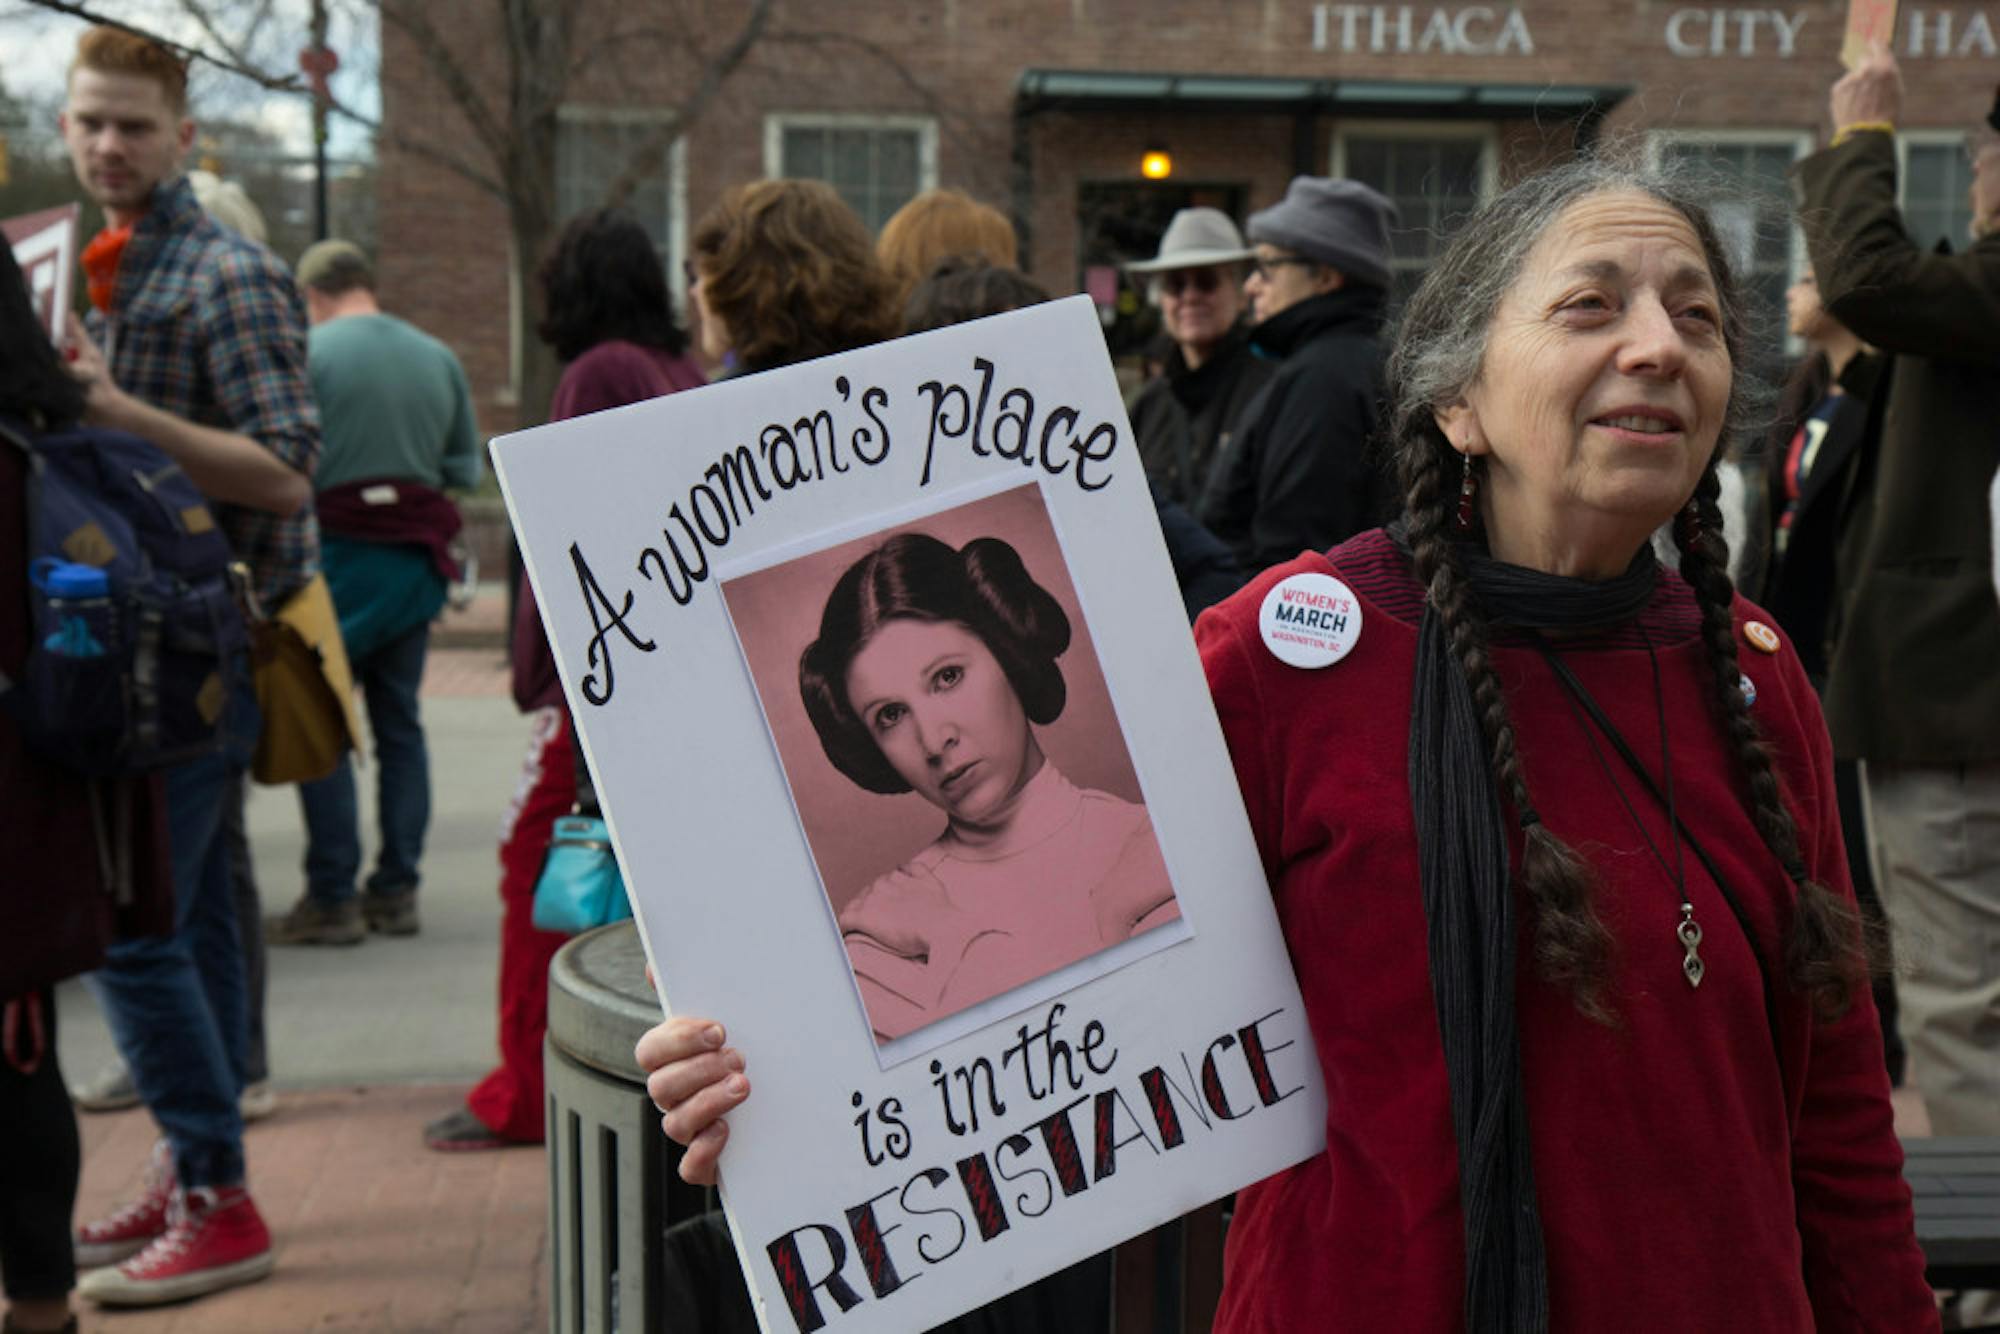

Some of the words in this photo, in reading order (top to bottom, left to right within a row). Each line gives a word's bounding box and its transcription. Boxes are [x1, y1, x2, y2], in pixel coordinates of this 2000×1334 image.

[1311, 8, 1534, 56] ITHACA
[1666, 8, 1807, 57] CITY
[571, 541, 656, 705] A
[639, 376, 890, 606] woman's
[918, 356, 1118, 490] place
[1276, 602, 1347, 632] MARCH
[1282, 588, 1350, 613] WOMEN'S
[851, 1090, 911, 1166] is
[930, 1059, 1006, 1135] in
[1002, 1003, 1118, 1101] the
[767, 1008, 1304, 1334] RESISTANCE
